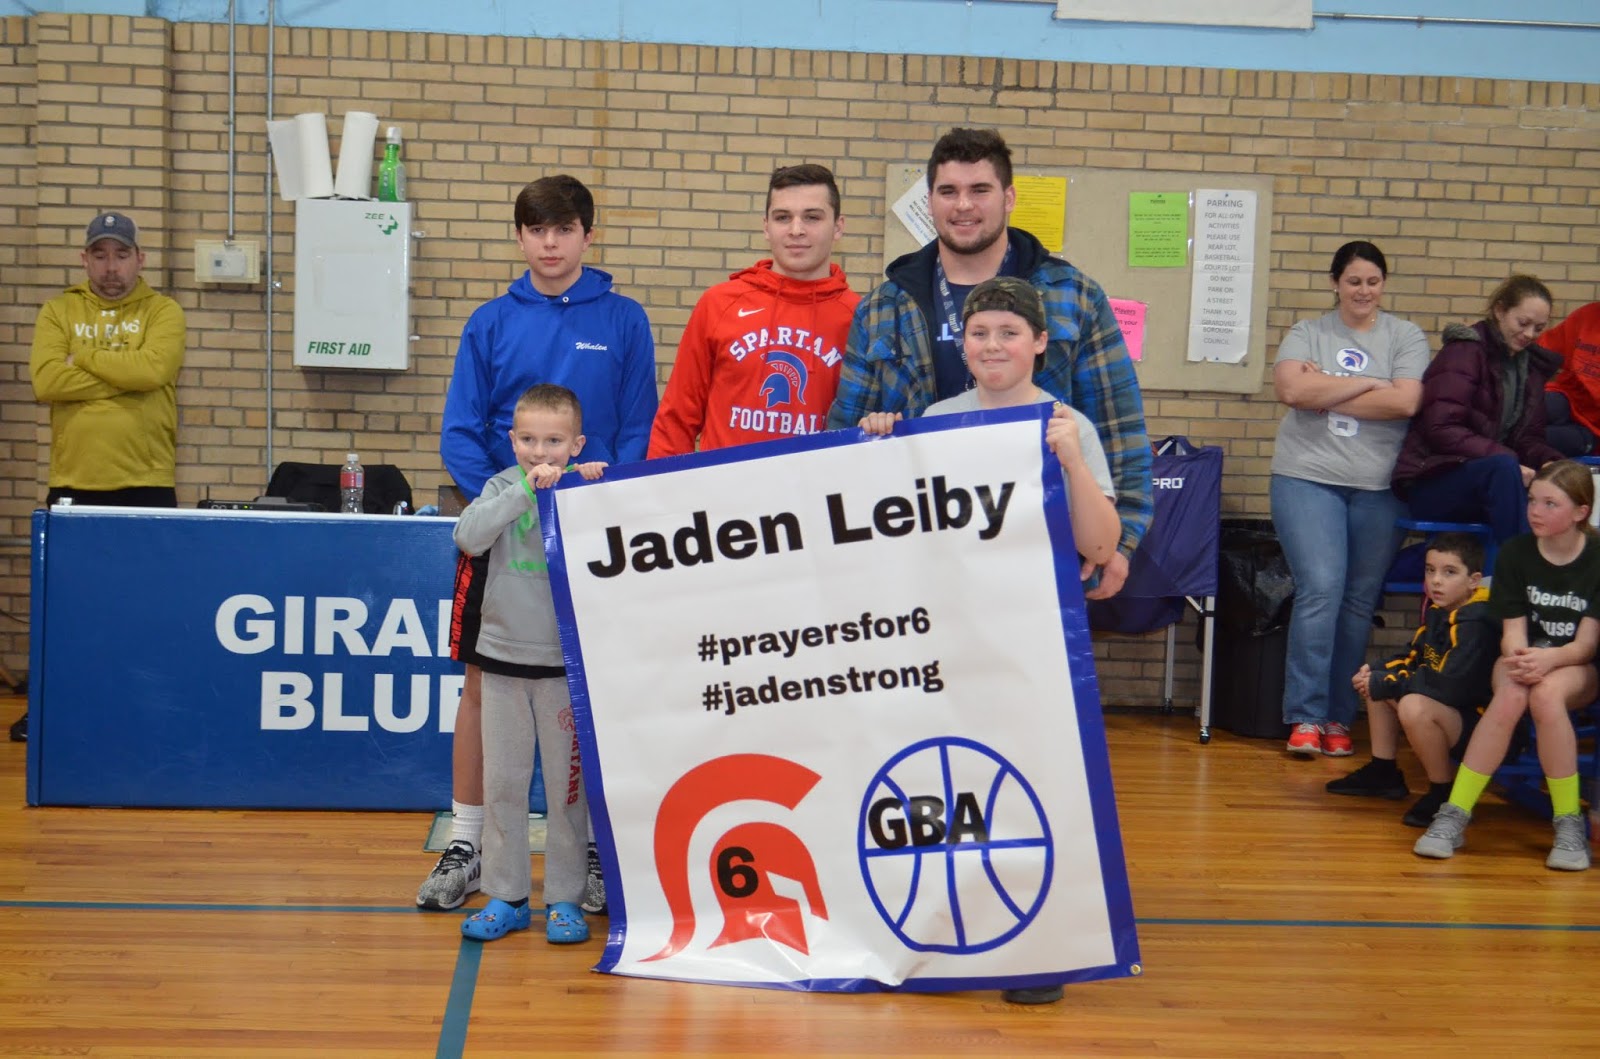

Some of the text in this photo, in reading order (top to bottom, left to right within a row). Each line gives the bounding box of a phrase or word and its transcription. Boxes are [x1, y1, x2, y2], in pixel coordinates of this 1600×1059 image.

[1207, 199, 1243, 208] PARKING
[1204, 253, 1241, 261] BASKETBALL
[1208, 243, 1224, 251] REAR
[1204, 263, 1228, 271] COURTS
[307, 341, 371, 356] FIRST AID
[575, 341, 608, 351] Whalen
[729, 326, 843, 368] SPARTAN
[729, 406, 826, 436] FOOTBAL
[587, 475, 1016, 579] Jaden Leiby
[215, 593, 453, 657] GIRA
[697, 606, 931, 666] #prayersfor6
[702, 660, 945, 716] #jadenstrong
[867, 791, 990, 850] GBA
[716, 846, 759, 899] 6
